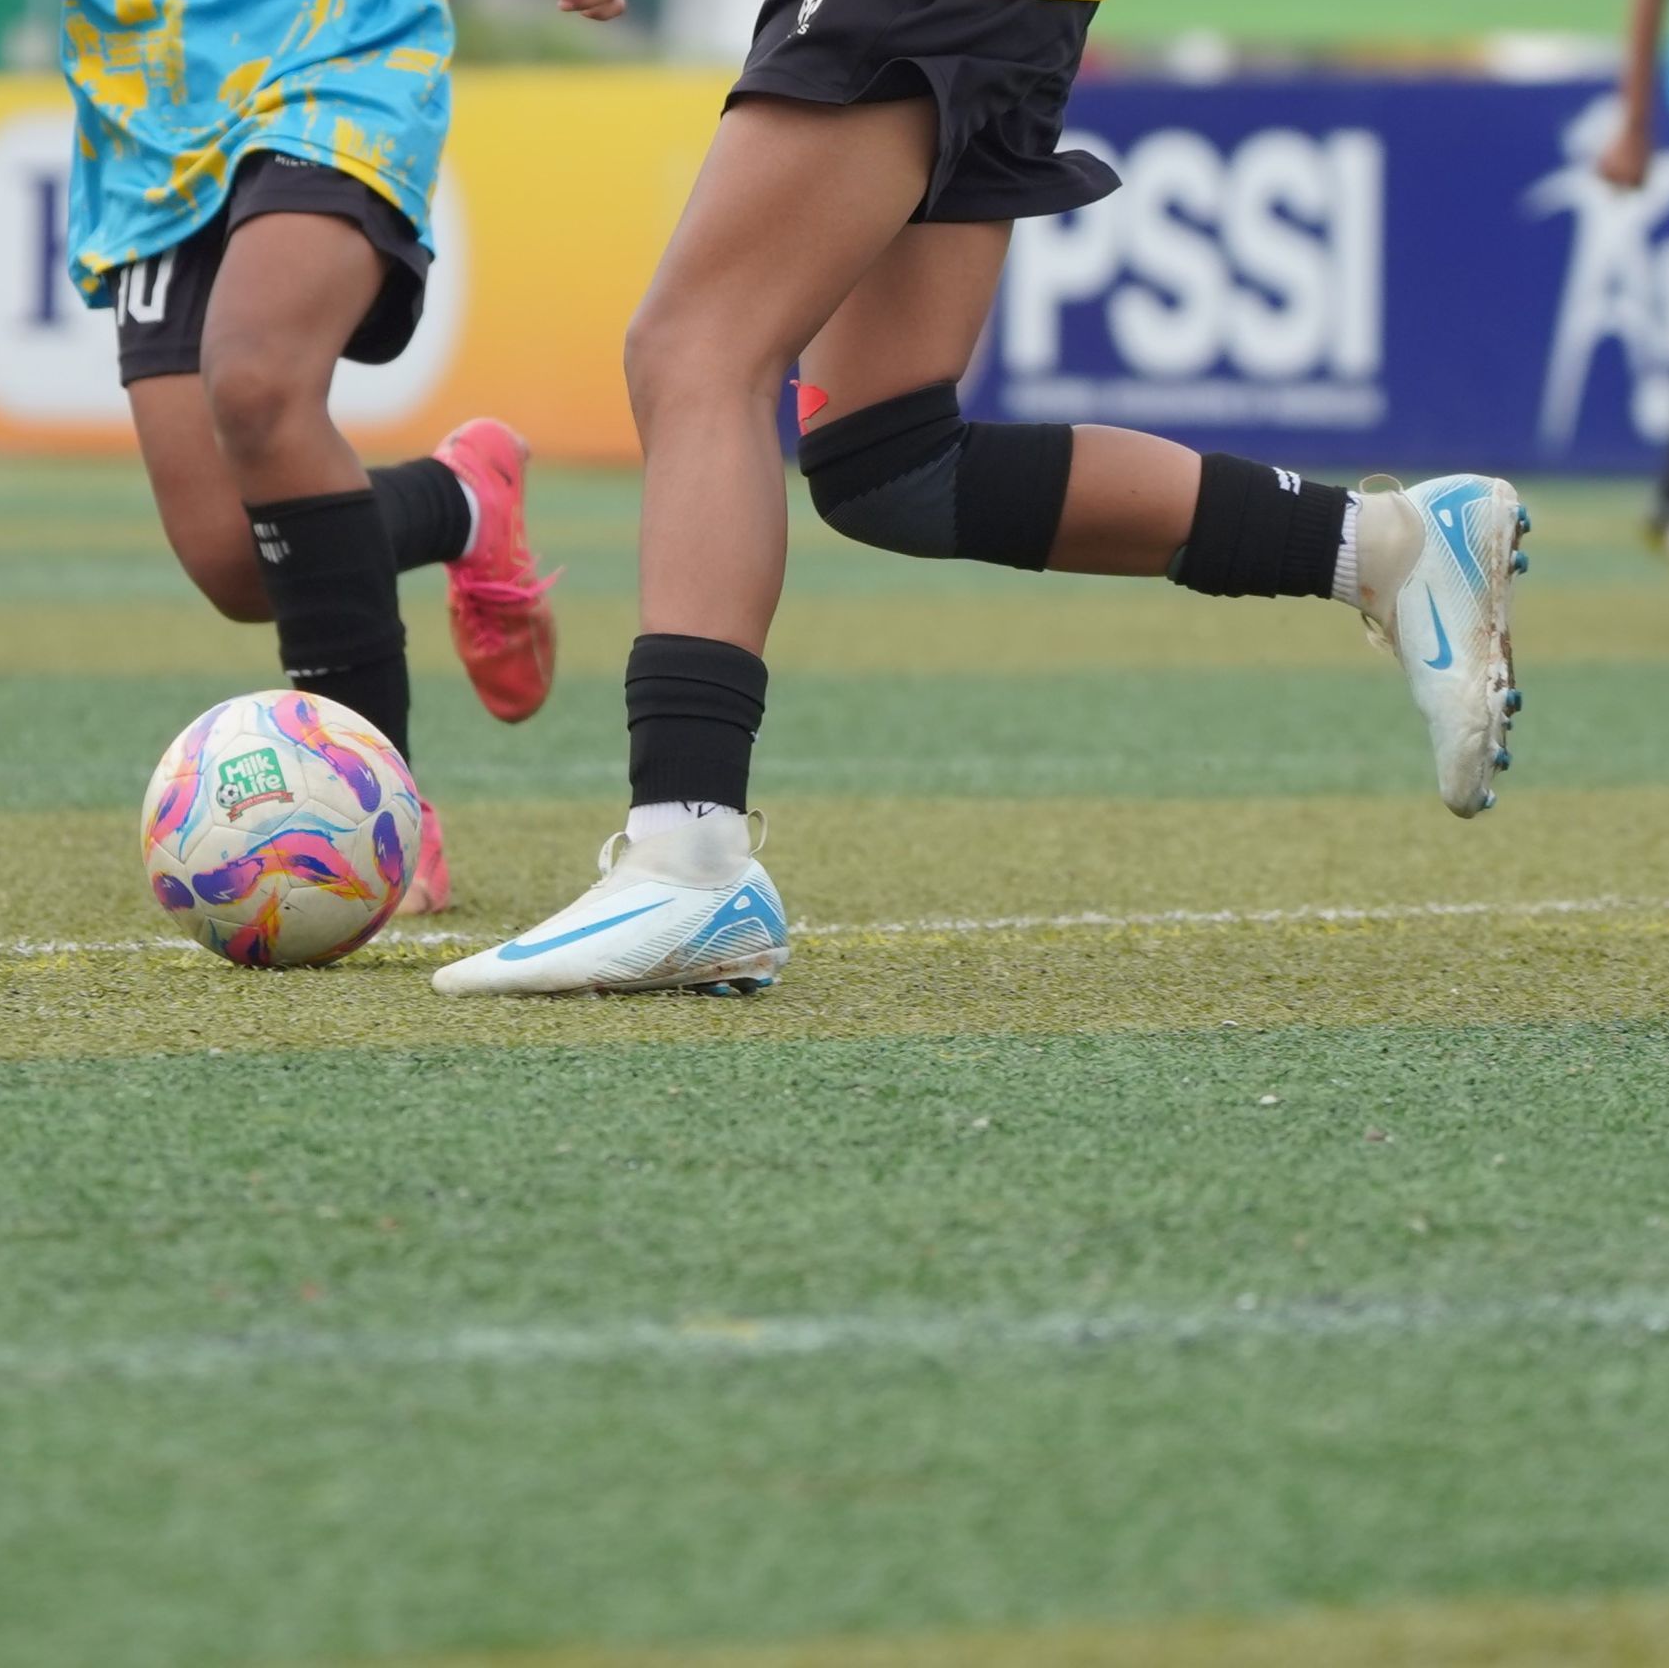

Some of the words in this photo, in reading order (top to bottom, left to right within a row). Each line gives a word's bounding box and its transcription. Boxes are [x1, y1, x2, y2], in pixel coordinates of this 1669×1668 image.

[1002, 128, 1383, 380] PSSI
[225, 753, 276, 783] Milk
[237, 772, 282, 800] Life
